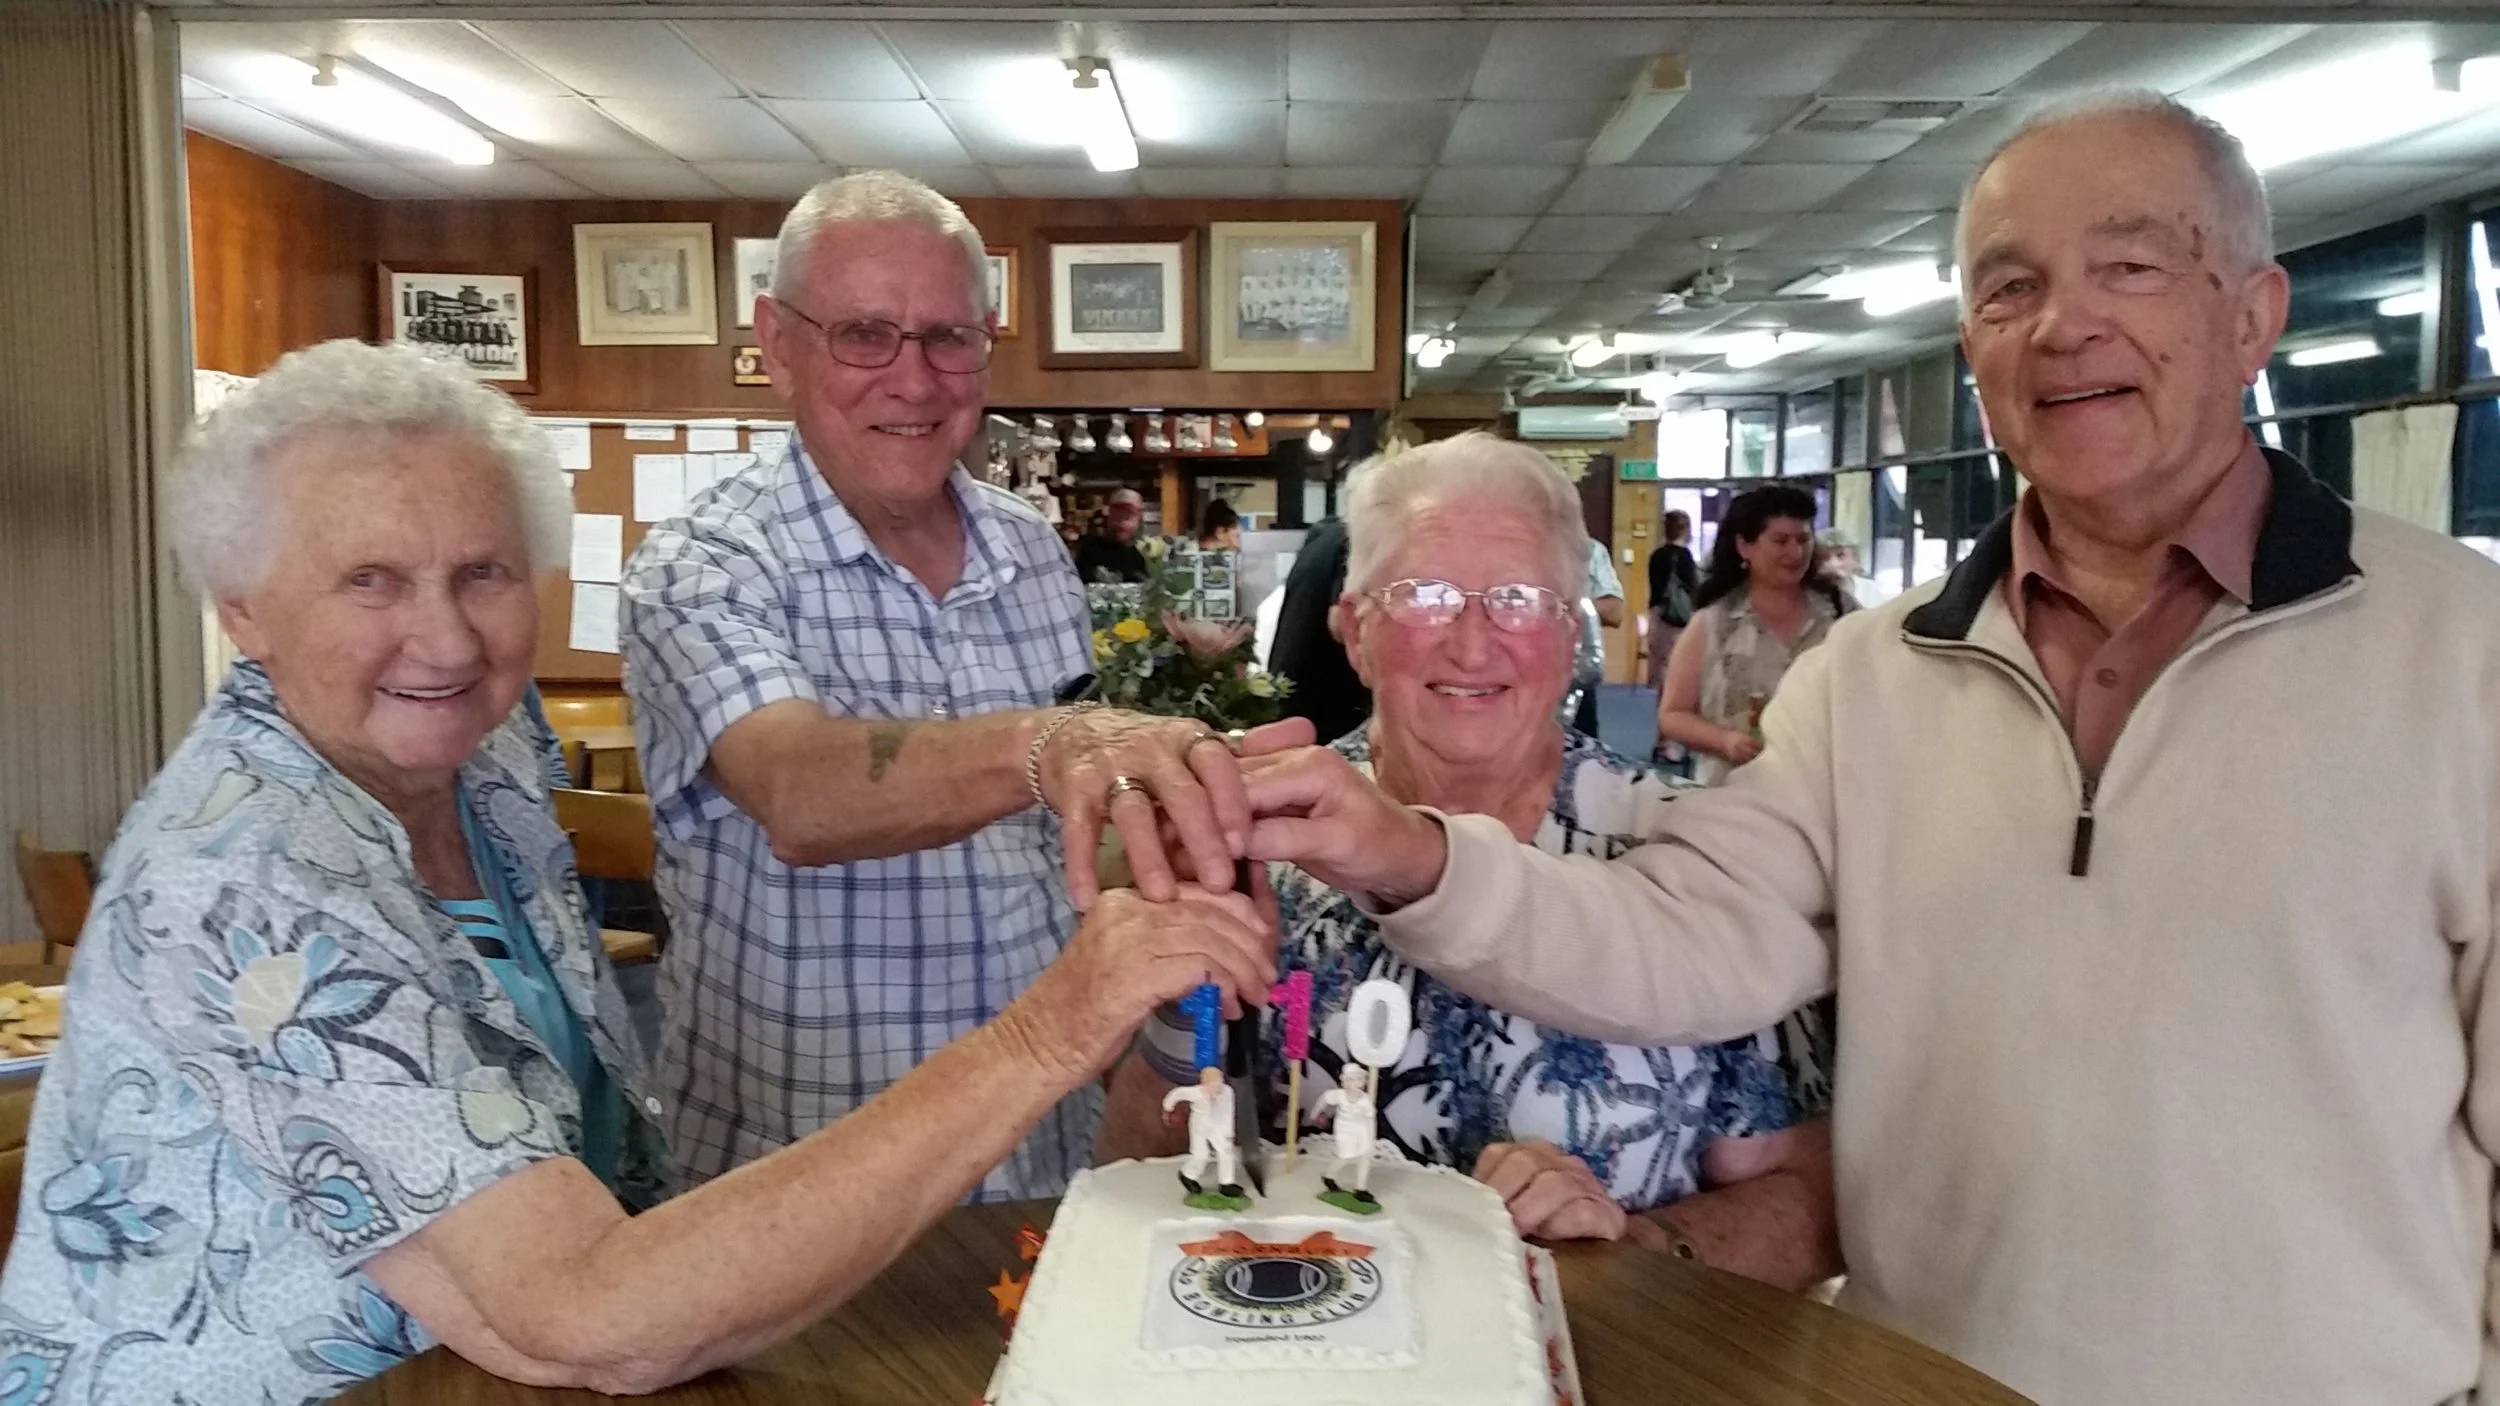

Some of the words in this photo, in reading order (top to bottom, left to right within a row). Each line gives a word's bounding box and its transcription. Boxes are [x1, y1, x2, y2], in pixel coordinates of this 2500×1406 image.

[1179, 982, 1222, 1069] 1
[1269, 971, 1313, 1060] 1
[1347, 979, 1412, 1068] 0
[1183, 1292, 1294, 1324] BOWLING
[1311, 1293, 1368, 1322] CLUB
